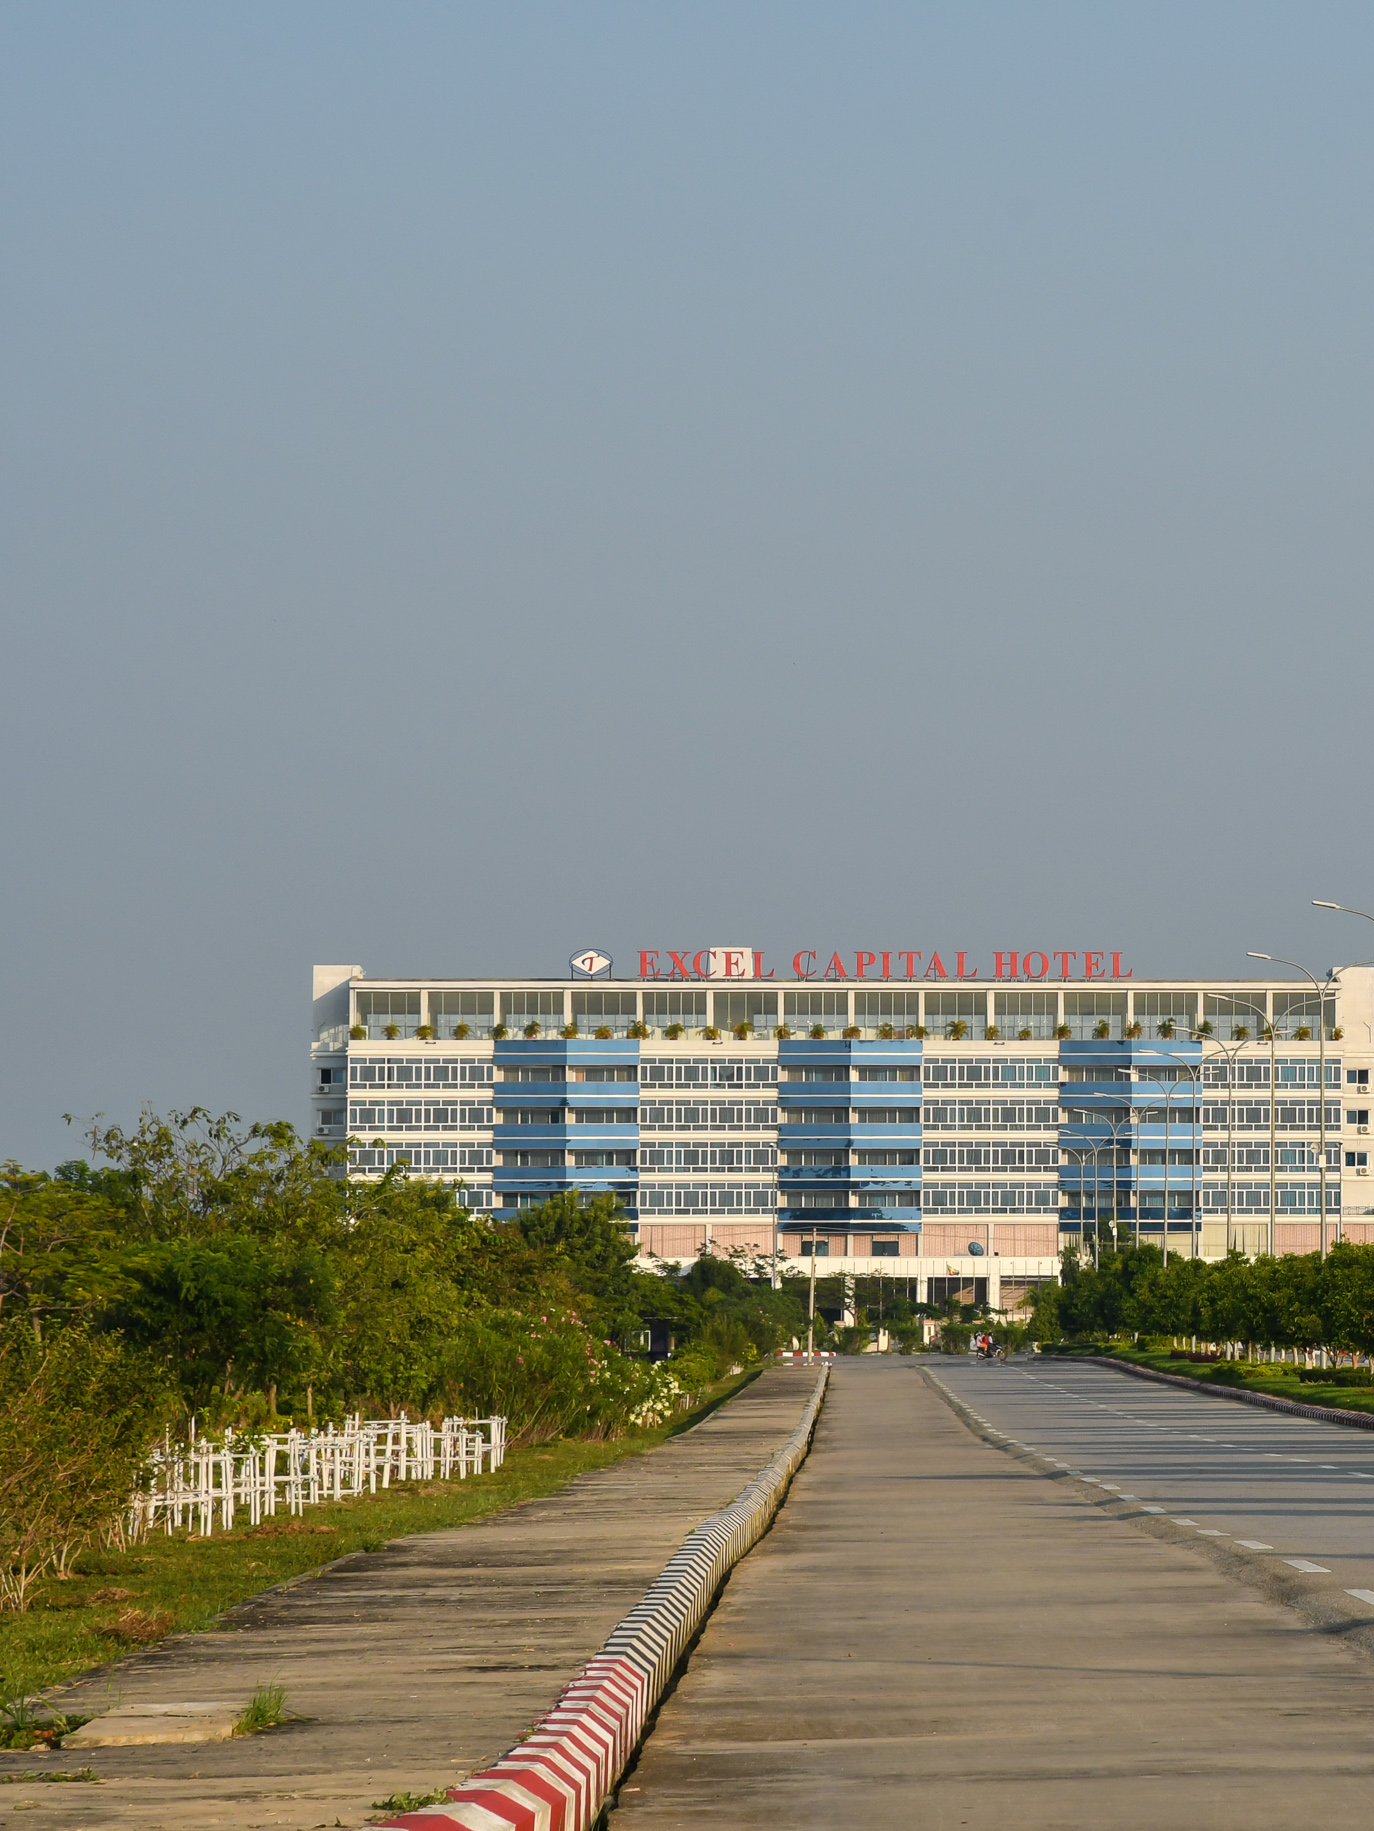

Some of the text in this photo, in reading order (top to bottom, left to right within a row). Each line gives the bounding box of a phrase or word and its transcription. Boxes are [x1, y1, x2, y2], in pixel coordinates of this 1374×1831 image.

[637, 950, 1133, 978] EXCEL CAPITAL HOTEL
